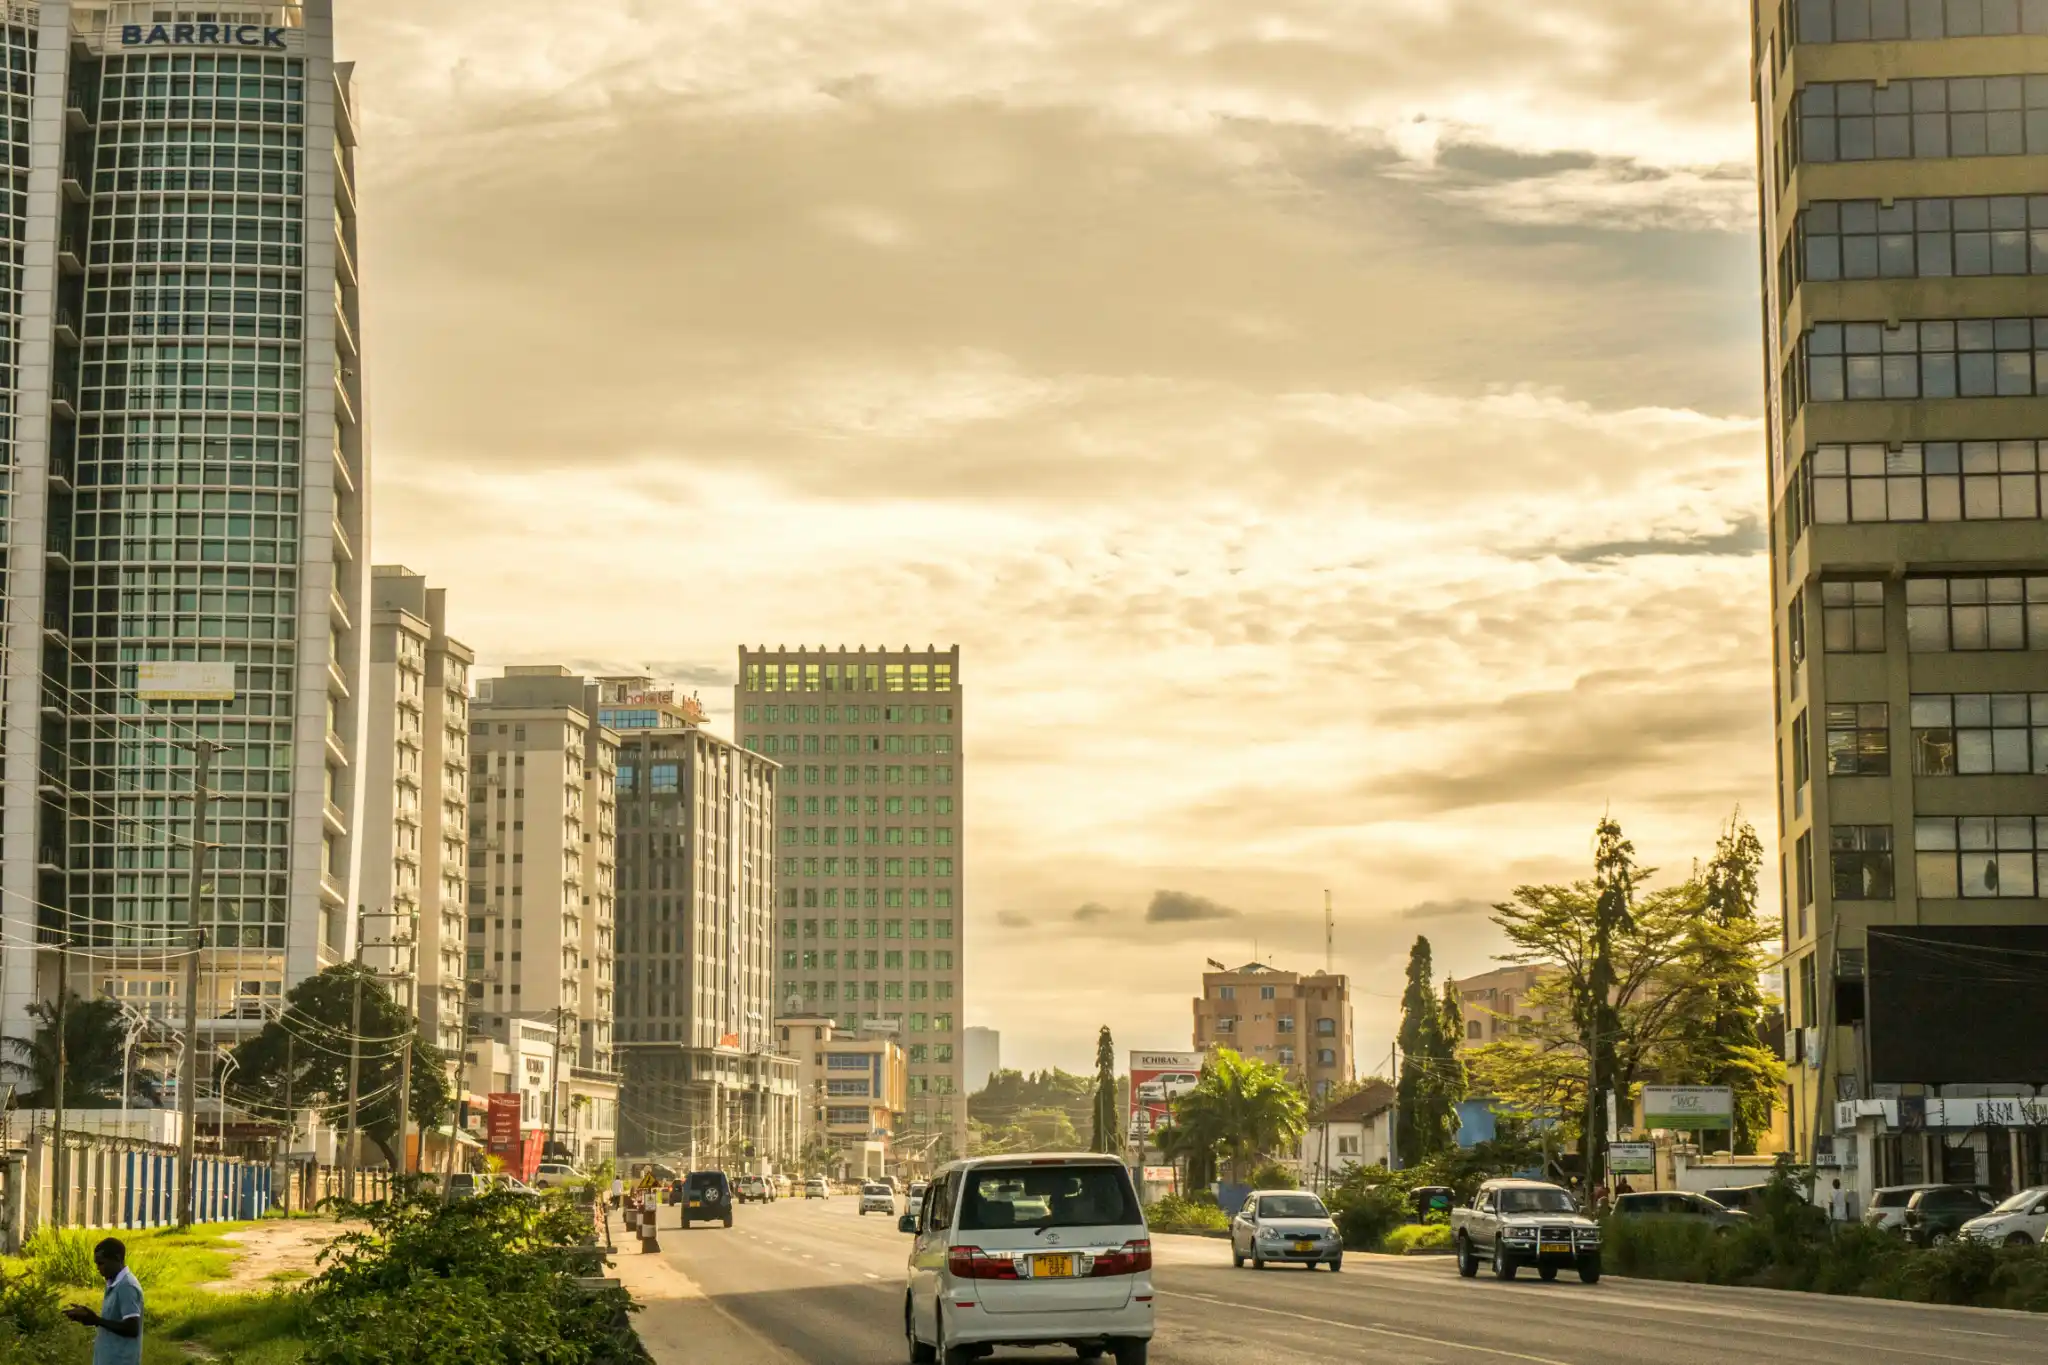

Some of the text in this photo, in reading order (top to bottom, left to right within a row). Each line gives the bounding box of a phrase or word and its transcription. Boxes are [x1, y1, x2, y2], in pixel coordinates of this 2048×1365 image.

[122, 24, 287, 48] BARRICK
[1142, 1056, 1178, 1065] ICHIBAN
[1976, 1102, 2013, 1113] EXIM
[1976, 1111, 2015, 1123] BANK
